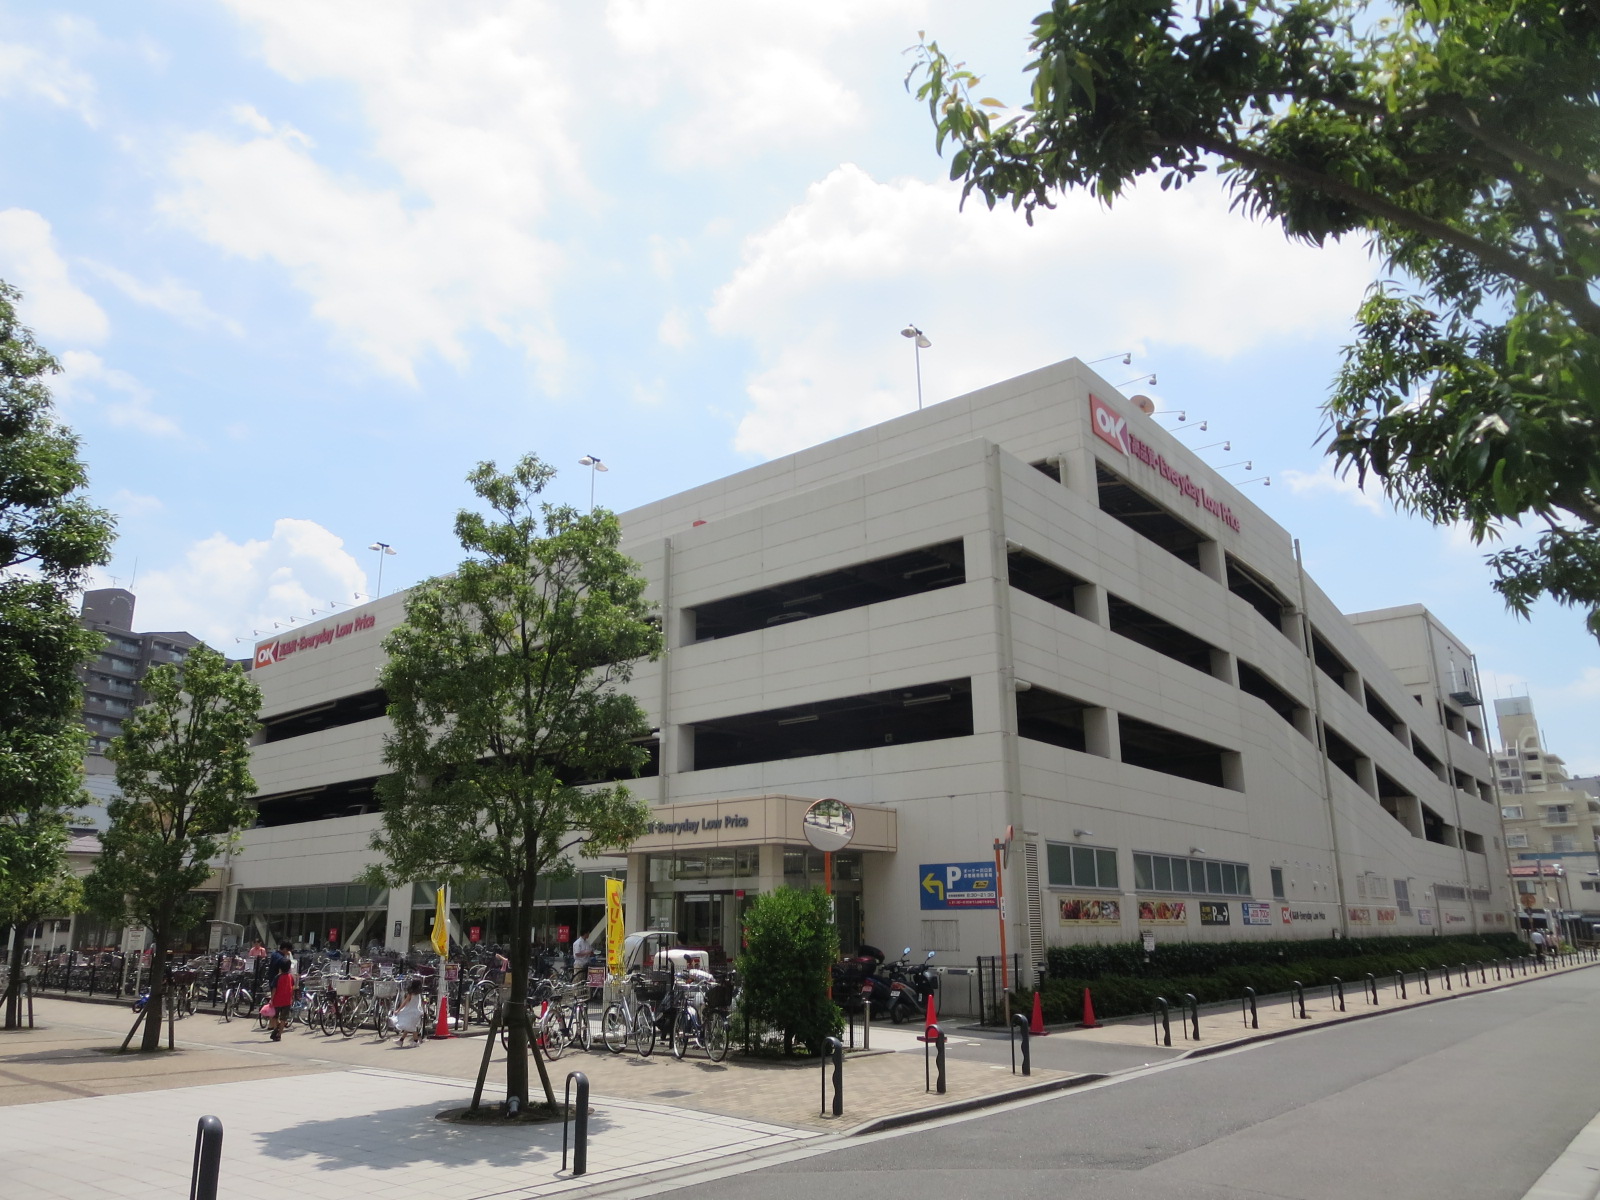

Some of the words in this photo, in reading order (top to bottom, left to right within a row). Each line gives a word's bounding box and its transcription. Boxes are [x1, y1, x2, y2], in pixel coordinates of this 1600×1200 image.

[1096, 407, 1129, 456] OK
[1159, 454, 1201, 507] Everyday
[1202, 487, 1221, 517] Low
[1221, 502, 1240, 533] Price
[335, 622, 354, 638] Low
[354, 614, 375, 632] Price
[258, 640, 279, 663] OK
[702, 817, 722, 831] Low
[725, 814, 749, 828] Price
[947, 866, 961, 889] P
[1212, 906, 1217, 921] P
[1283, 908, 1293, 924] OK
